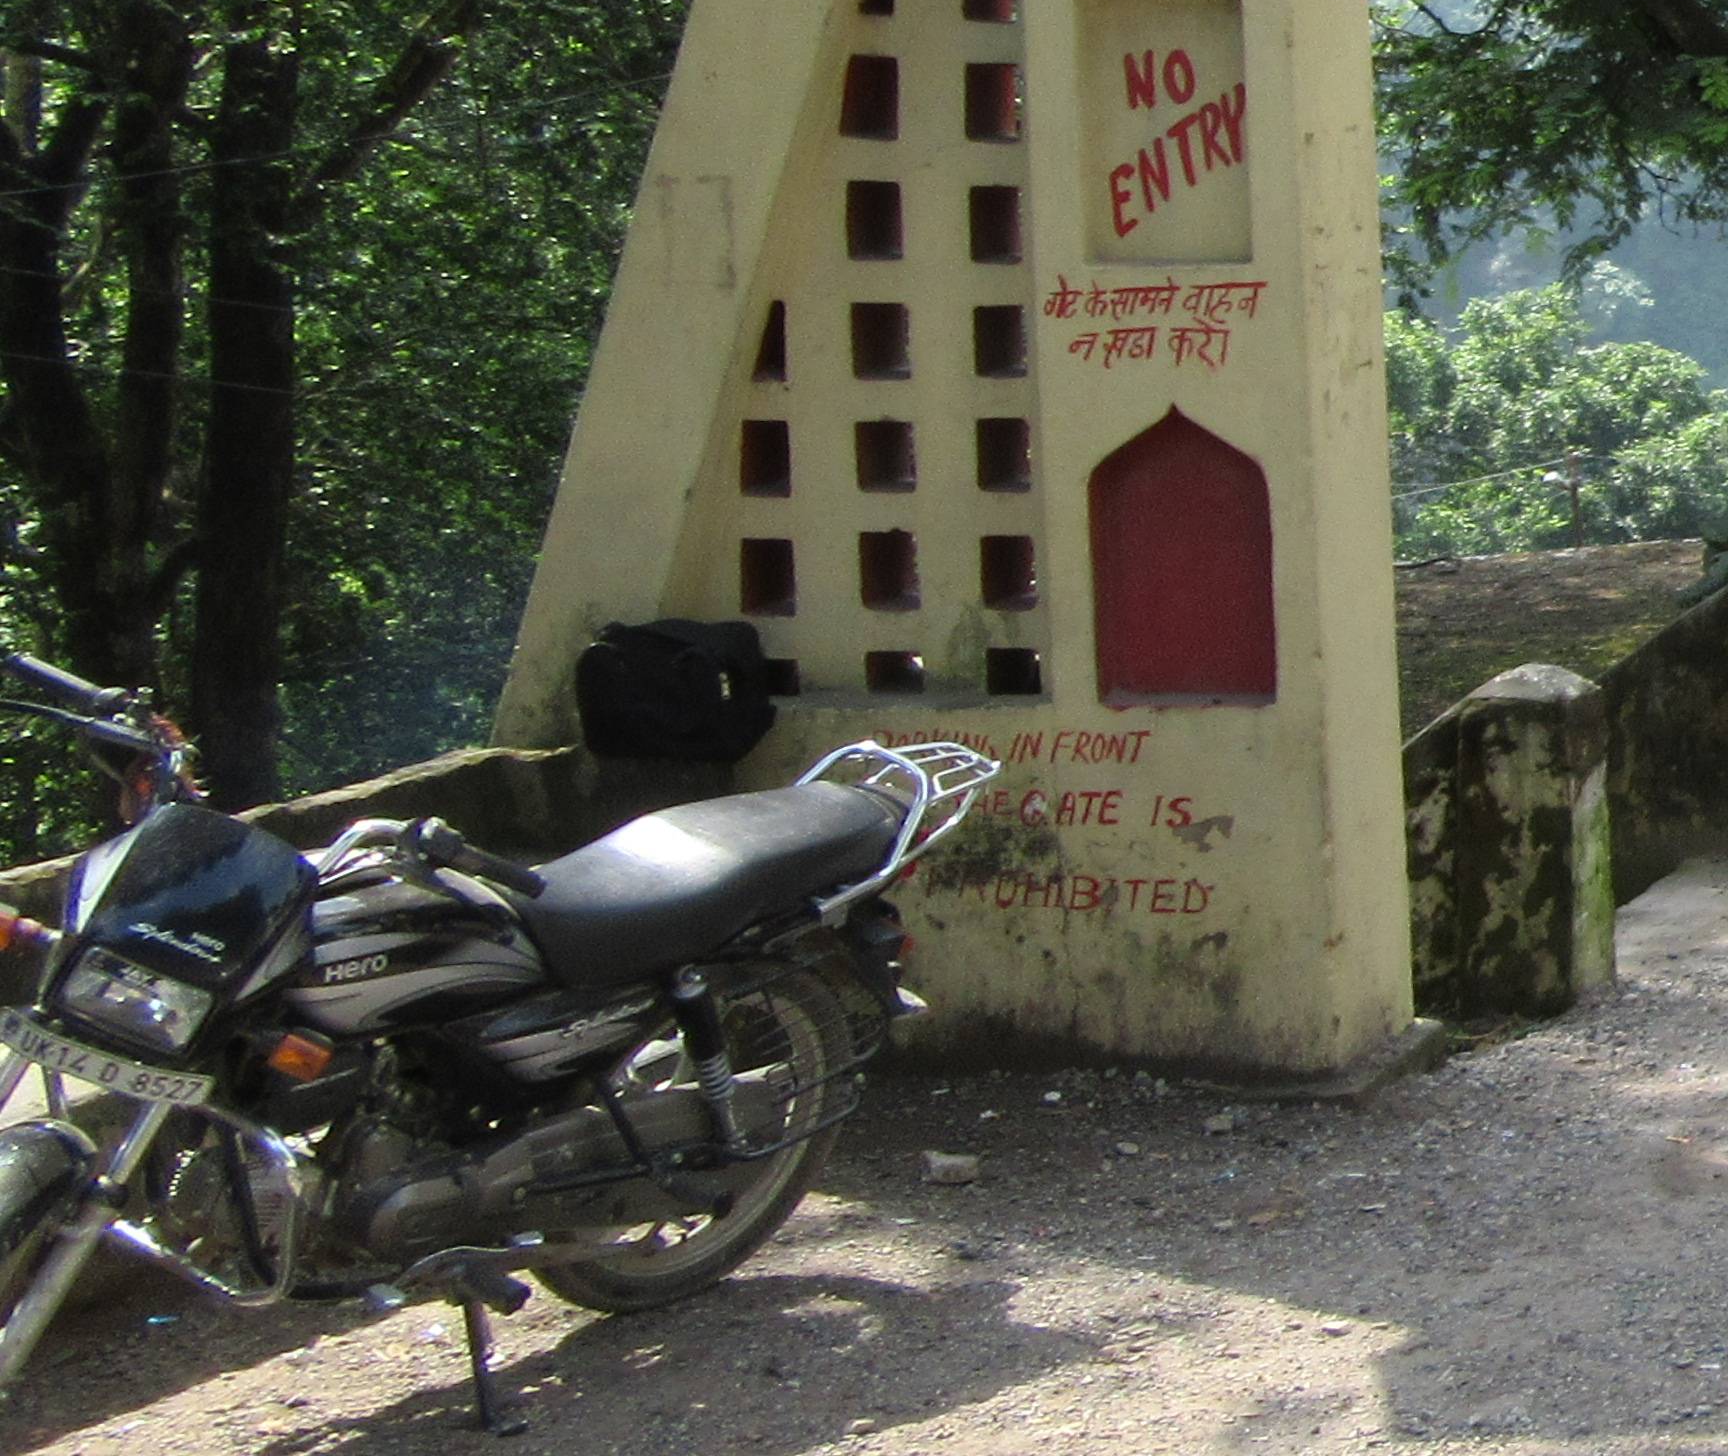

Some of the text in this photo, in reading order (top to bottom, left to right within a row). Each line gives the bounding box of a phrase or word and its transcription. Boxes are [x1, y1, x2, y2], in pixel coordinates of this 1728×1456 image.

[1123, 49, 1196, 110] NO
[1109, 82, 1247, 237] ENTRY
[1182, 281, 1268, 325] वाहन
[1068, 333, 1099, 361] न
[1010, 731, 1043, 763] IN
[1050, 730, 1153, 764] FRONT
[1020, 789, 1124, 828] GATE
[1149, 795, 1194, 828] IS
[323, 952, 389, 984] Hero
[130, 1072, 204, 1101] 8527
